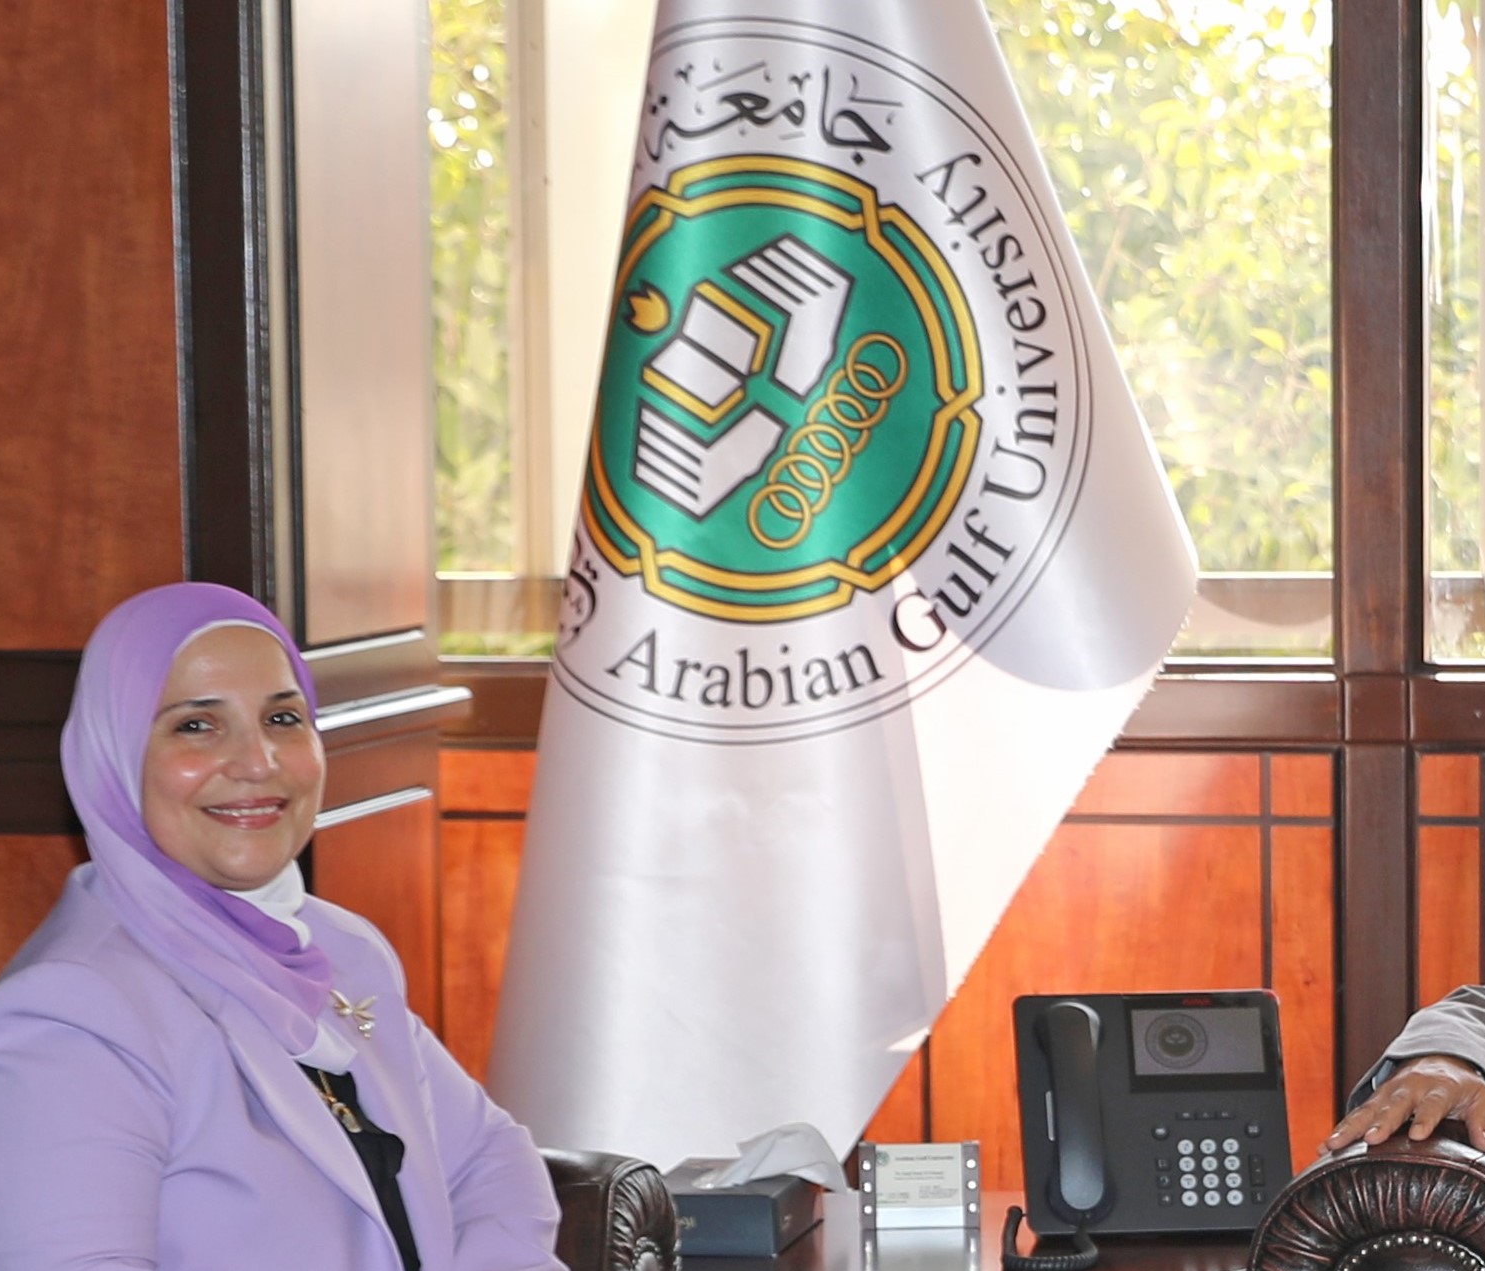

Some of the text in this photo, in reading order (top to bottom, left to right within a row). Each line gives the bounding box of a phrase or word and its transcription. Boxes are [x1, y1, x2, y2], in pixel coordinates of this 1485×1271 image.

[604, 151, 1059, 709] Arabian Gulf University
